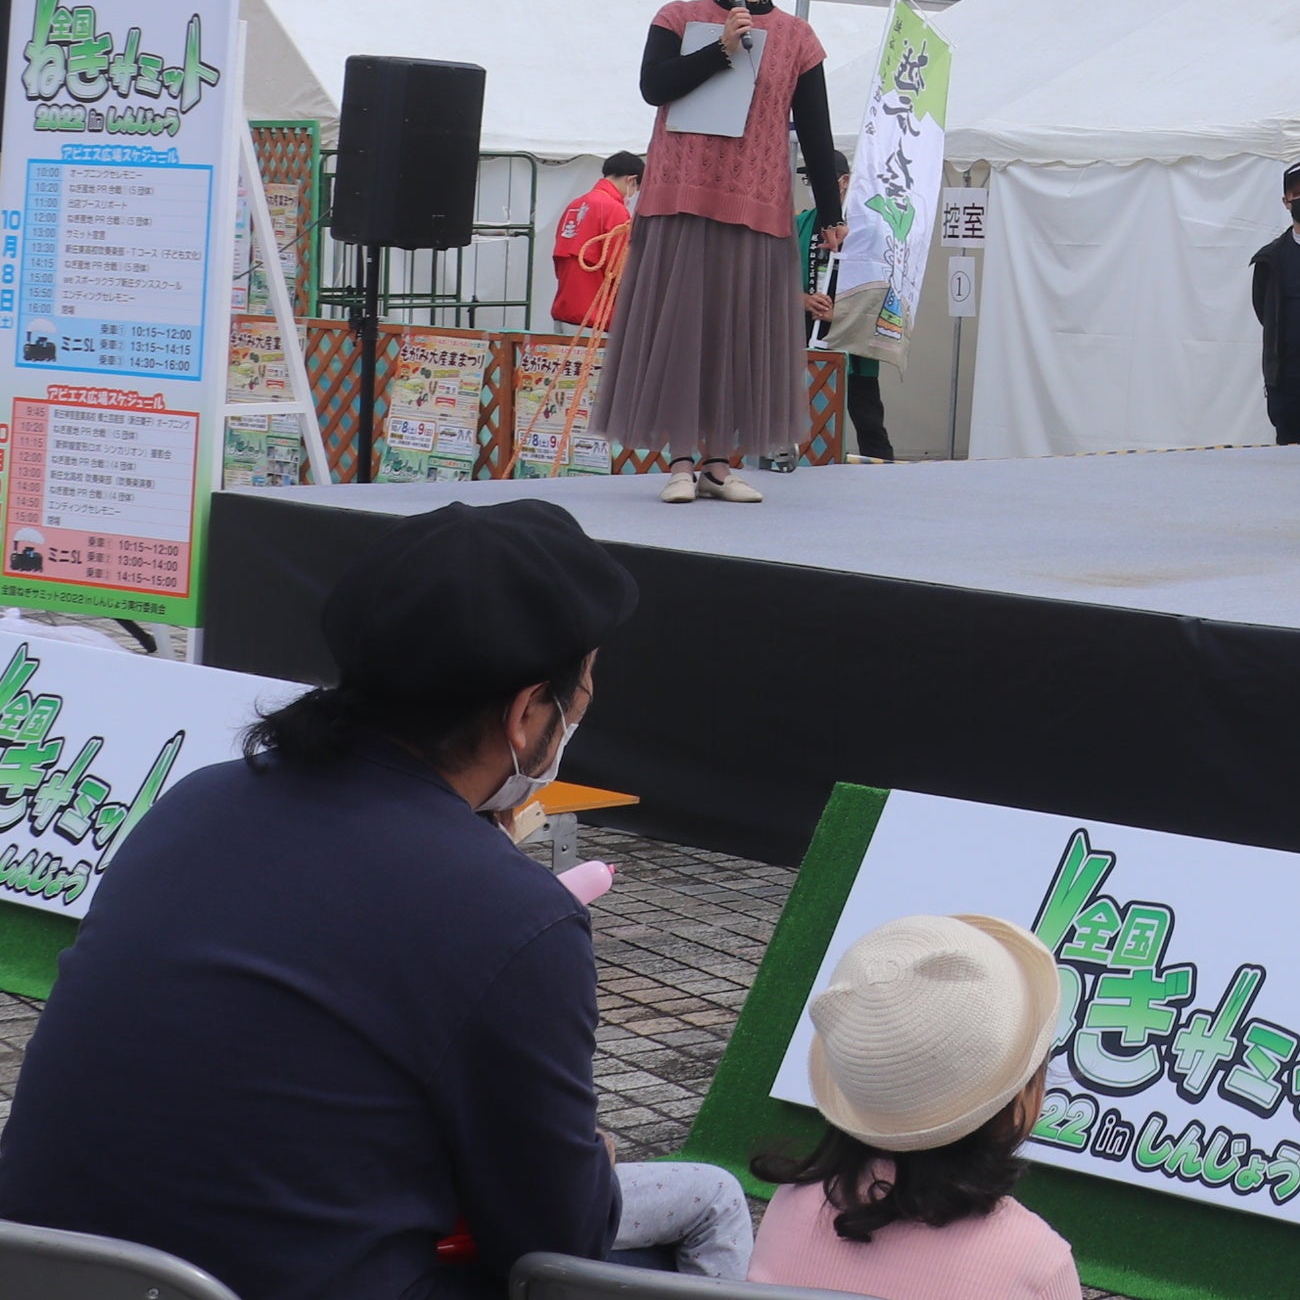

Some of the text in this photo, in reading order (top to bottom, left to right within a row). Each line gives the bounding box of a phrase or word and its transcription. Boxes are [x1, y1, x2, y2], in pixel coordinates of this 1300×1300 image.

[50, 6, 95, 41] 全国
[34, 103, 86, 132] 2022
[106, 105, 181, 137] しんじょう
[943, 203, 985, 240] 控室
[61, 336, 96, 353] ミニSL
[48, 546, 83, 565] ミニSL
[0, 642, 186, 874] ぎサミッ
[1062, 898, 1171, 968] 全国
[1093, 1107, 1133, 1157] in
